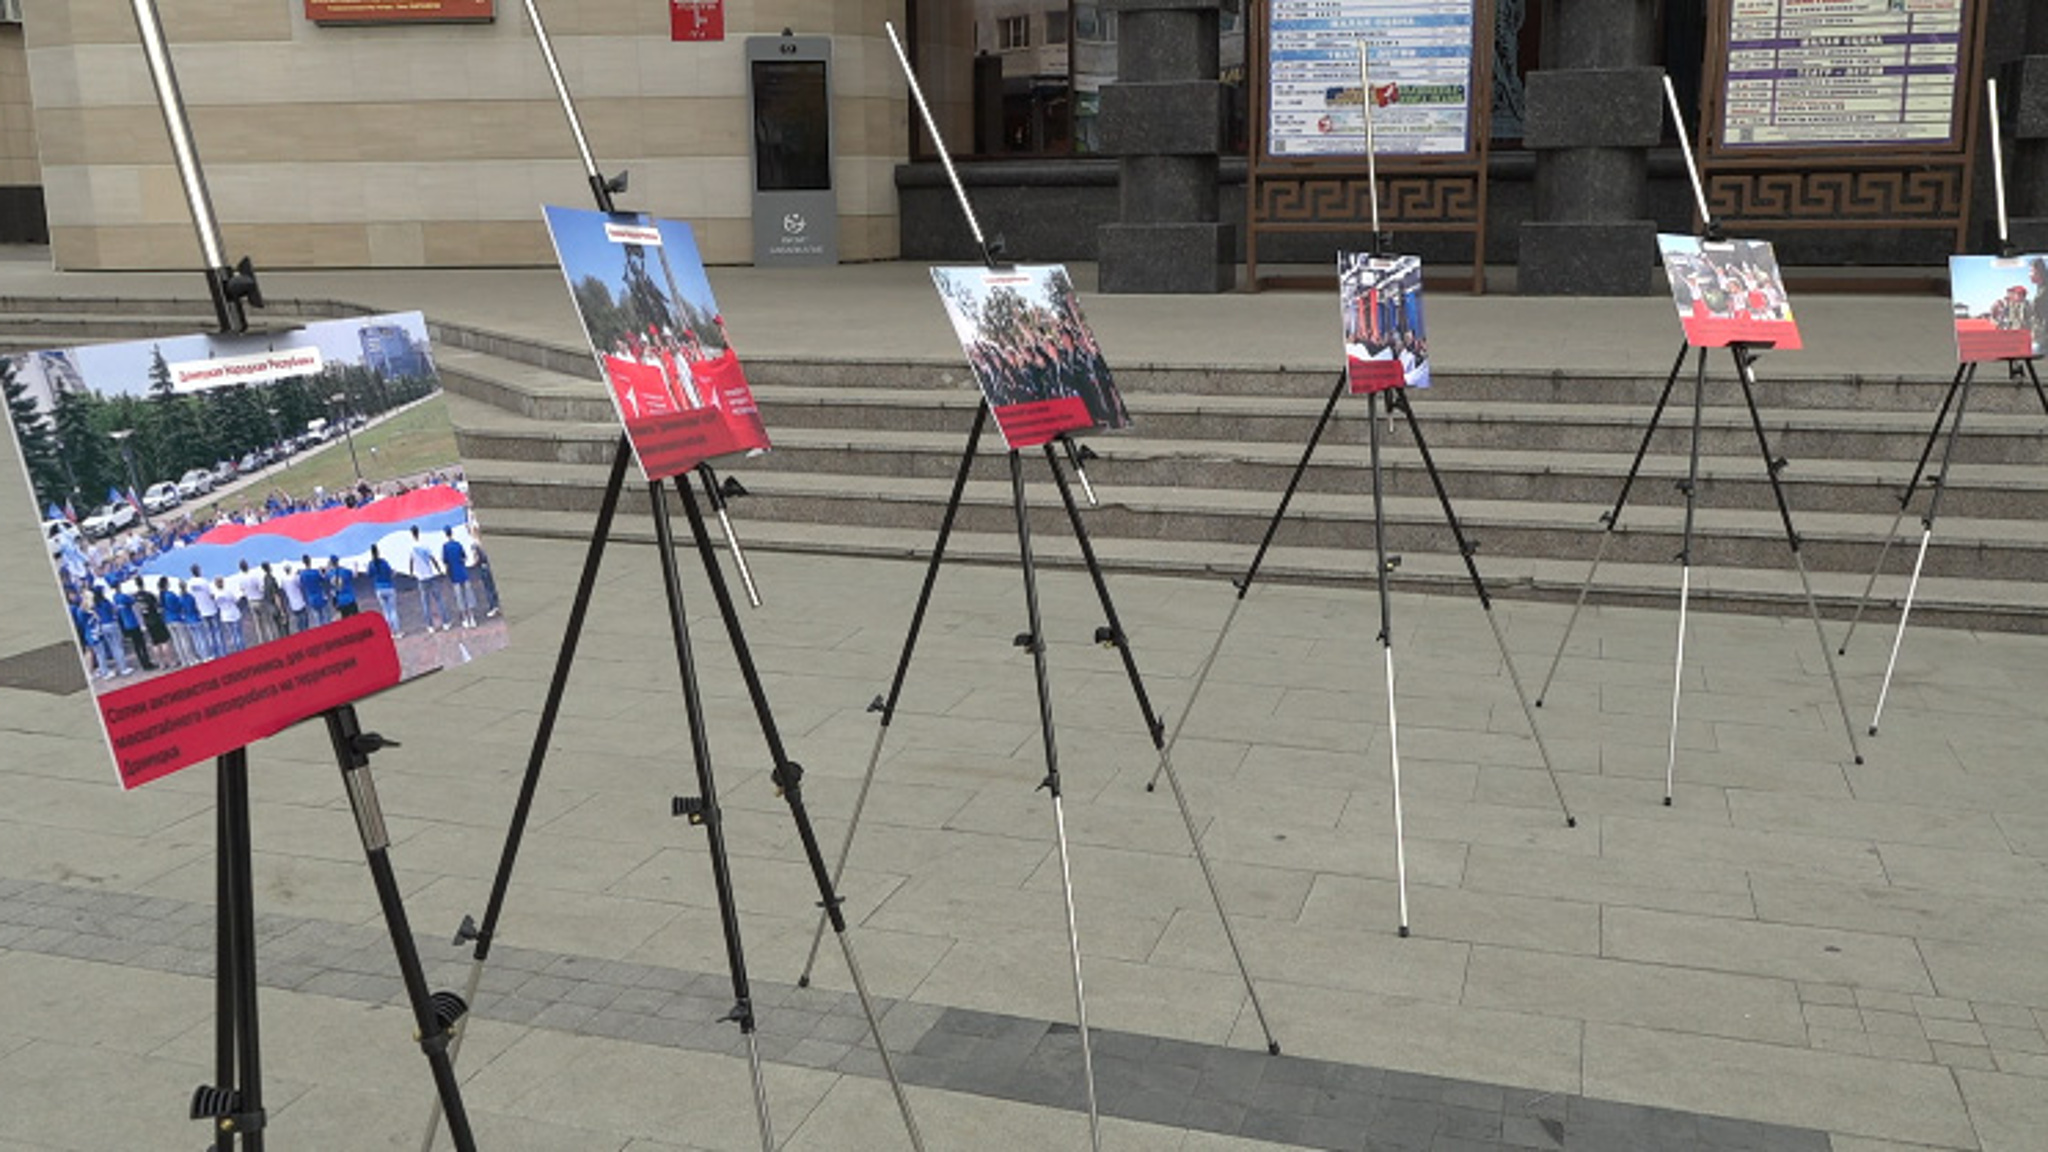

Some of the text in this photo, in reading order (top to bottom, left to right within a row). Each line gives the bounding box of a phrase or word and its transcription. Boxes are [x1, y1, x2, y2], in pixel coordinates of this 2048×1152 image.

[107, 702, 147, 724] Сотни
[150, 678, 220, 710] активистов
[285, 651, 305, 666] для
[305, 627, 374, 658] организации
[115, 656, 358, 749] масштабного автопробега на территории
[123, 745, 181, 776] Донецка
